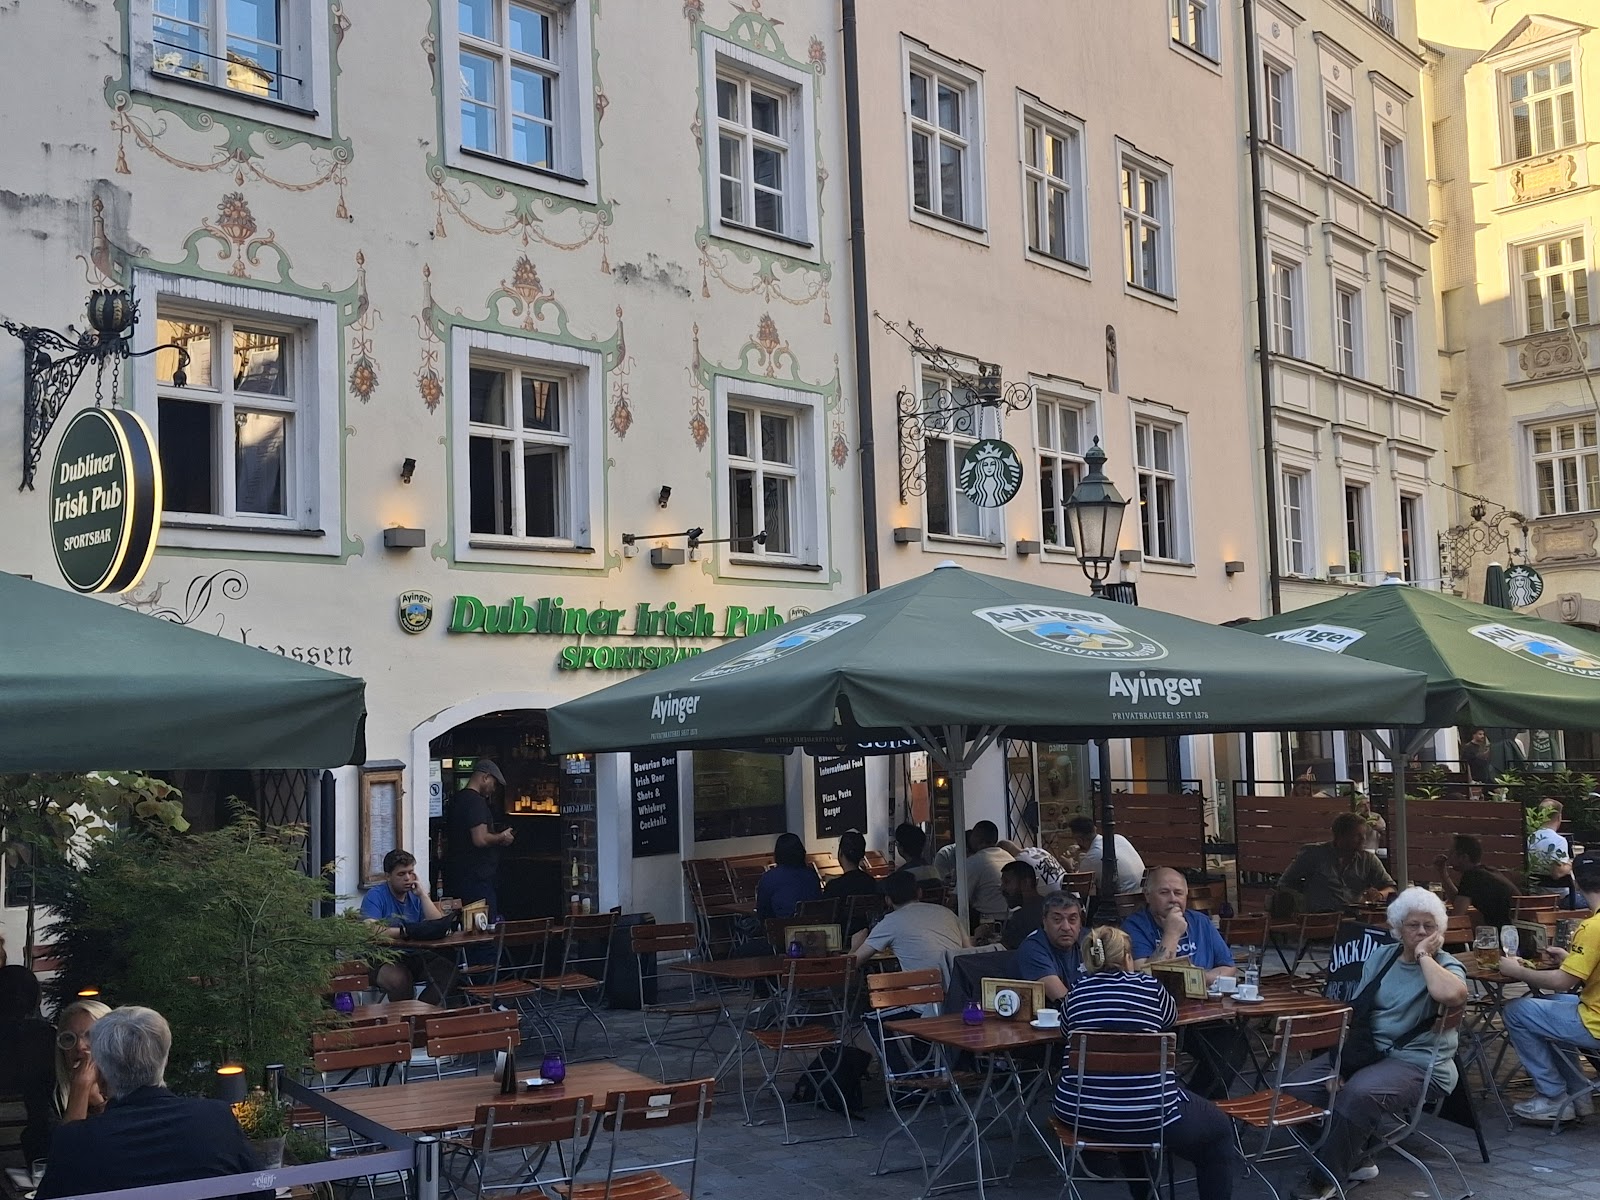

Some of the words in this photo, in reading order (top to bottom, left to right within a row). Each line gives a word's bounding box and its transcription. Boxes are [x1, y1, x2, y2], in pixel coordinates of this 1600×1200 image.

[60, 452, 116, 484] Dubliner
[54, 490, 88, 523] Irish
[91, 481, 122, 513] Pub
[63, 528, 112, 552] SPORTSBAR
[402, 592, 431, 603] Ayinger
[451, 595, 627, 635] Dubliner
[635, 601, 716, 637] Irish
[725, 605, 785, 637] Pub
[986, 608, 1104, 624] Ayinger
[1109, 671, 1202, 705] Ayinger
[651, 692, 701, 725] Ayinger
[1112, 712, 1174, 720] PRIVATBRAUEREI
[1194, 711, 1209, 719] 1878
[634, 760, 661, 773] Bavarian
[661, 757, 675, 767] Beer
[819, 760, 851, 776] International
[852, 757, 863, 768] Food
[635, 775, 650, 787] Irish
[651, 773, 665, 784] Beer
[636, 790, 654, 801] Shots
[655, 787, 660, 798] &
[638, 802, 667, 816] Whiskeys
[823, 804, 841, 818] Burger
[639, 815, 667, 830] Cocktails
[1329, 939, 1360, 974] JACK
